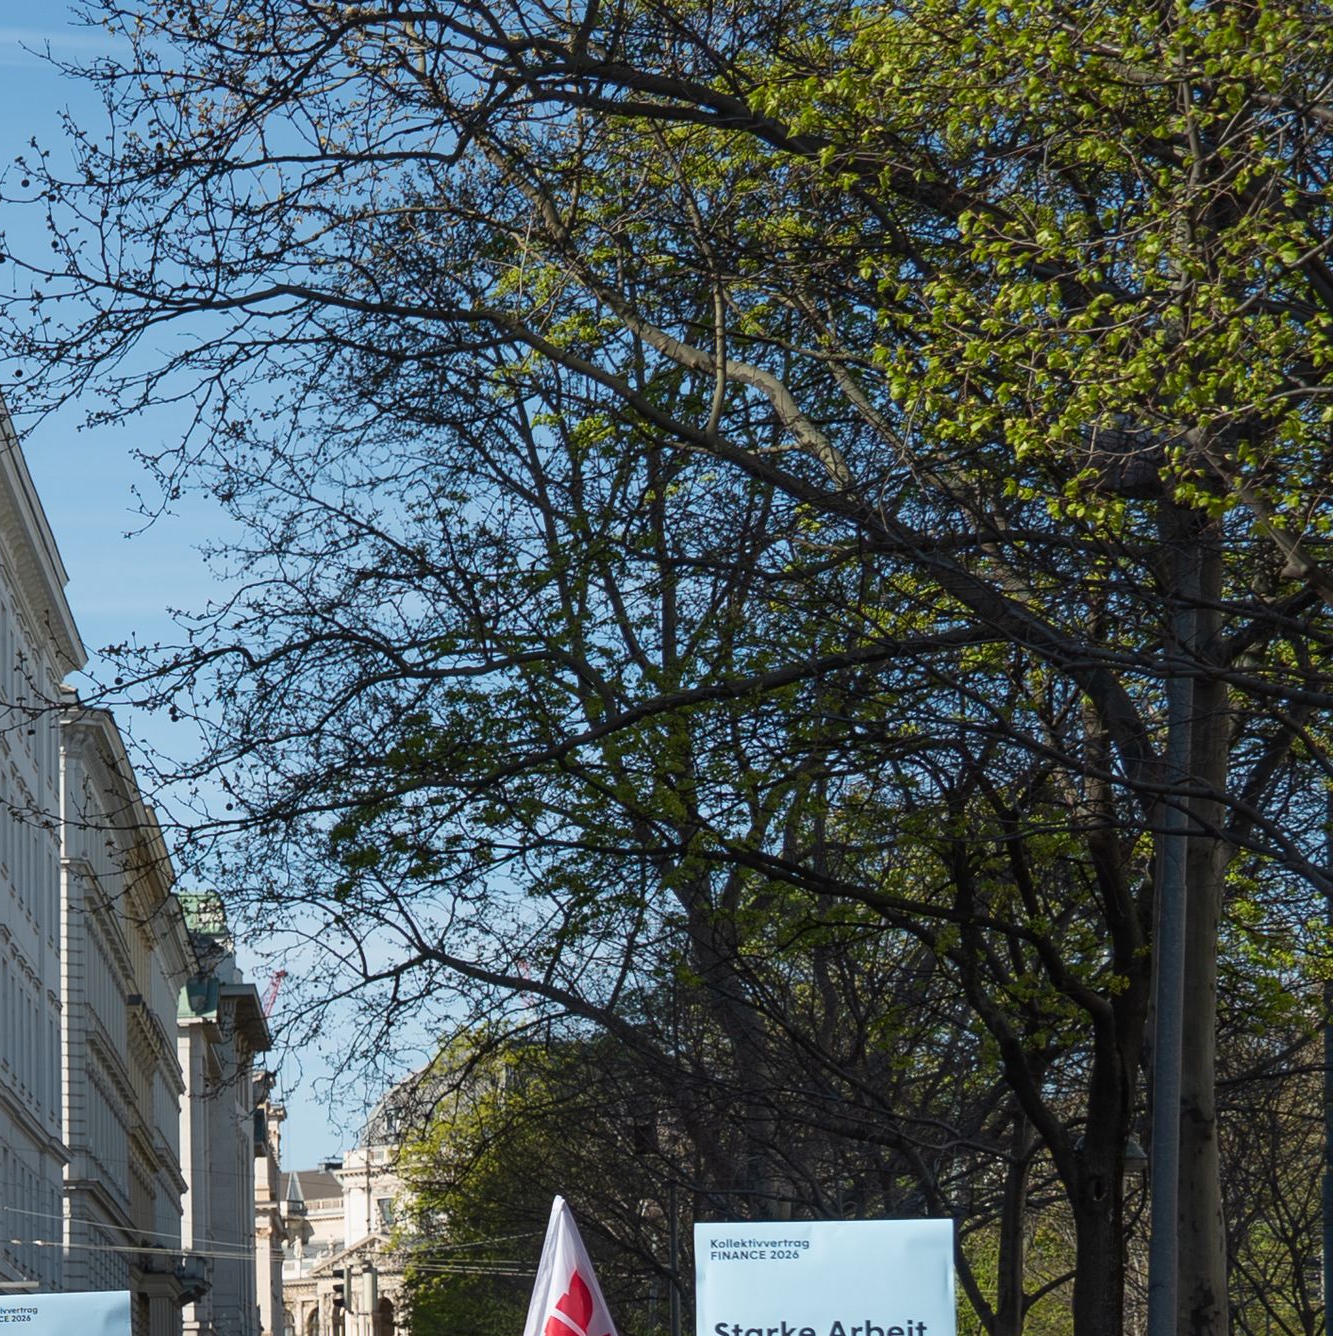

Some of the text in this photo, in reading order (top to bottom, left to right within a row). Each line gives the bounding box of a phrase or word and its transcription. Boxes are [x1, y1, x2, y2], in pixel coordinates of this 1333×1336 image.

[710, 1238, 810, 1250] Kollektivvertrag
[710, 1249, 800, 1261] FINANCE 2026
[11, 1314, 31, 1323] 2026
